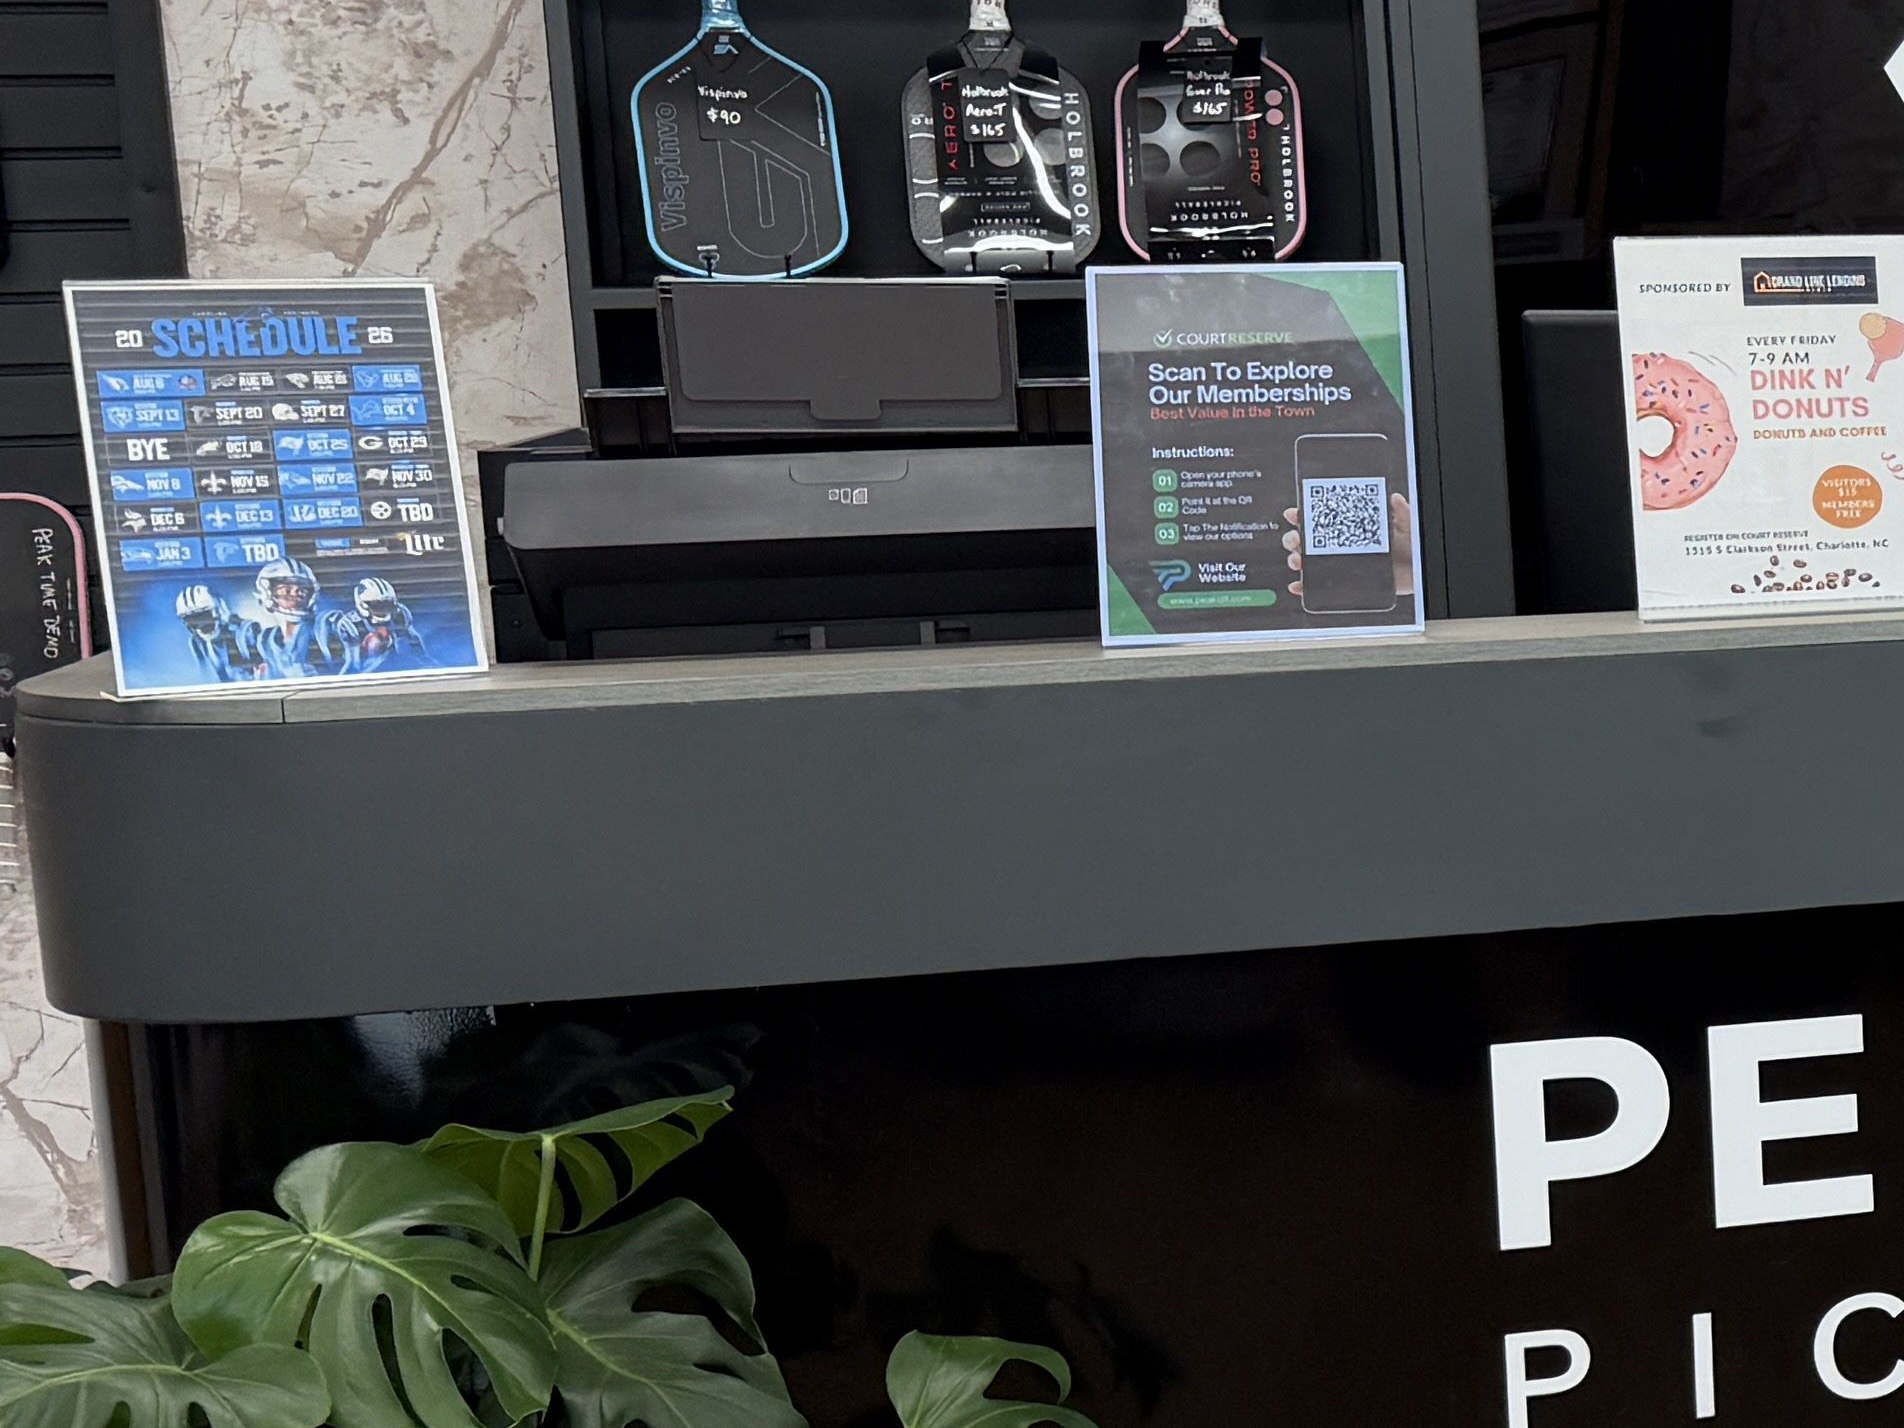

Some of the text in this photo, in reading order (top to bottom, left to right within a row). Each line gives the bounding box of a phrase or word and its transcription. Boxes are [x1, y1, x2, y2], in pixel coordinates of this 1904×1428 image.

[706, 107, 741, 125] $90
[655, 101, 690, 232] Vispinvo
[1063, 92, 1092, 237] HOLBROOK
[1280, 135, 1295, 222] HOLBROOK
[1639, 282, 1732, 294] SPONSORED BY
[115, 316, 394, 358] 20 SCHEDULE 26
[1746, 334, 1837, 347] EVERY FRIDAY
[1748, 351, 1811, 366] 7-9 AM
[1148, 360, 1334, 384] Scan To Explore
[1750, 368, 1817, 392] DINK
[1149, 382, 1352, 406] Our Memberships
[215, 407, 242, 420] SEPT
[301, 405, 327, 417] SEPT
[1150, 404, 1315, 420] Best Value In the Town
[1752, 397, 1870, 421] DONUTS
[1809, 427, 1837, 439] AND
[1838, 426, 1888, 438] COFFEE
[126, 438, 171, 461] BYE
[1151, 446, 1235, 459] Instructions:
[230, 476, 254, 488] NOV
[311, 473, 336, 484] NOV
[391, 469, 433, 483] NOV 30
[1158, 475, 1172, 486] 01
[145, 479, 170, 491] NOV
[317, 507, 340, 519] DEC
[397, 503, 434, 522] TBD
[1158, 502, 1174, 513] 02
[150, 513, 174, 526] DEC
[234, 510, 258, 523] DEC
[1159, 529, 1176, 540] 03
[32, 528, 54, 566] PEAK
[1872, 538, 1890, 549] NC
[156, 546, 192, 561] JAN 3
[241, 543, 280, 563] TBD
[1225, 562, 1247, 573] Our
[1198, 572, 1247, 583] Website
